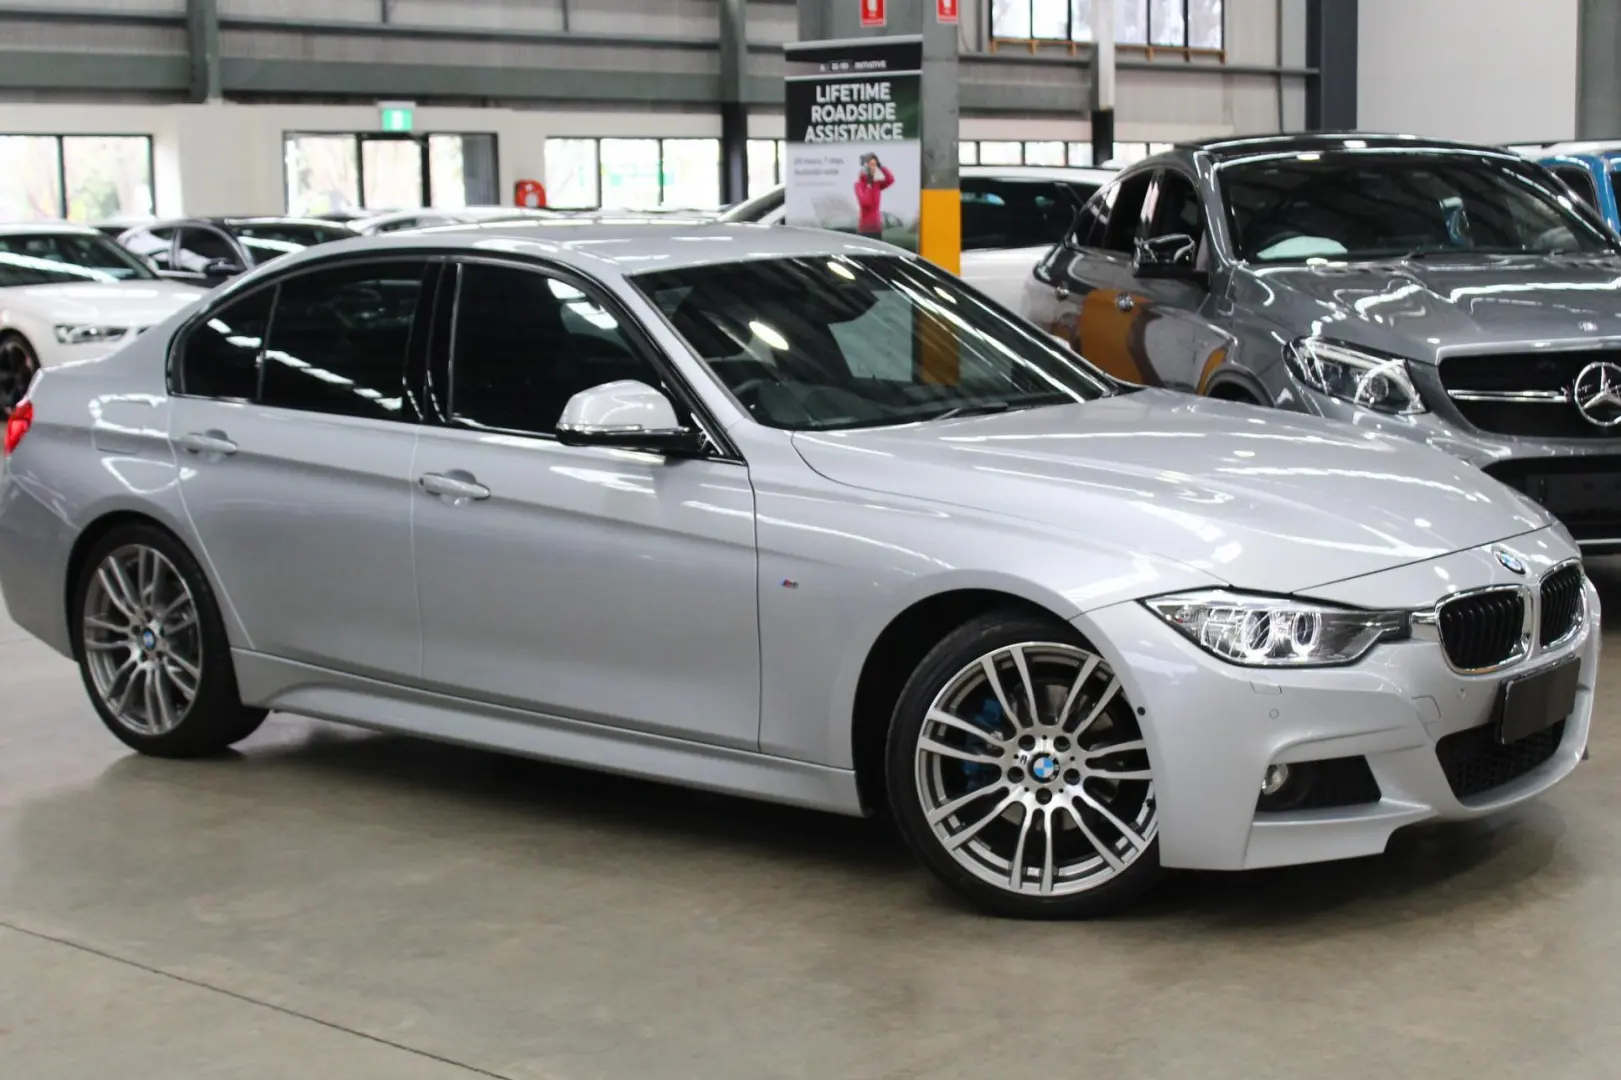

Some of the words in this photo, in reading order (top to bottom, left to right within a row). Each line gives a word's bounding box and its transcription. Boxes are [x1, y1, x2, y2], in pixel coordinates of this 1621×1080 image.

[816, 83, 891, 102] LIFETIME
[811, 103, 896, 122] ROADSIDE
[804, 123, 903, 142] ASSISTANCE
